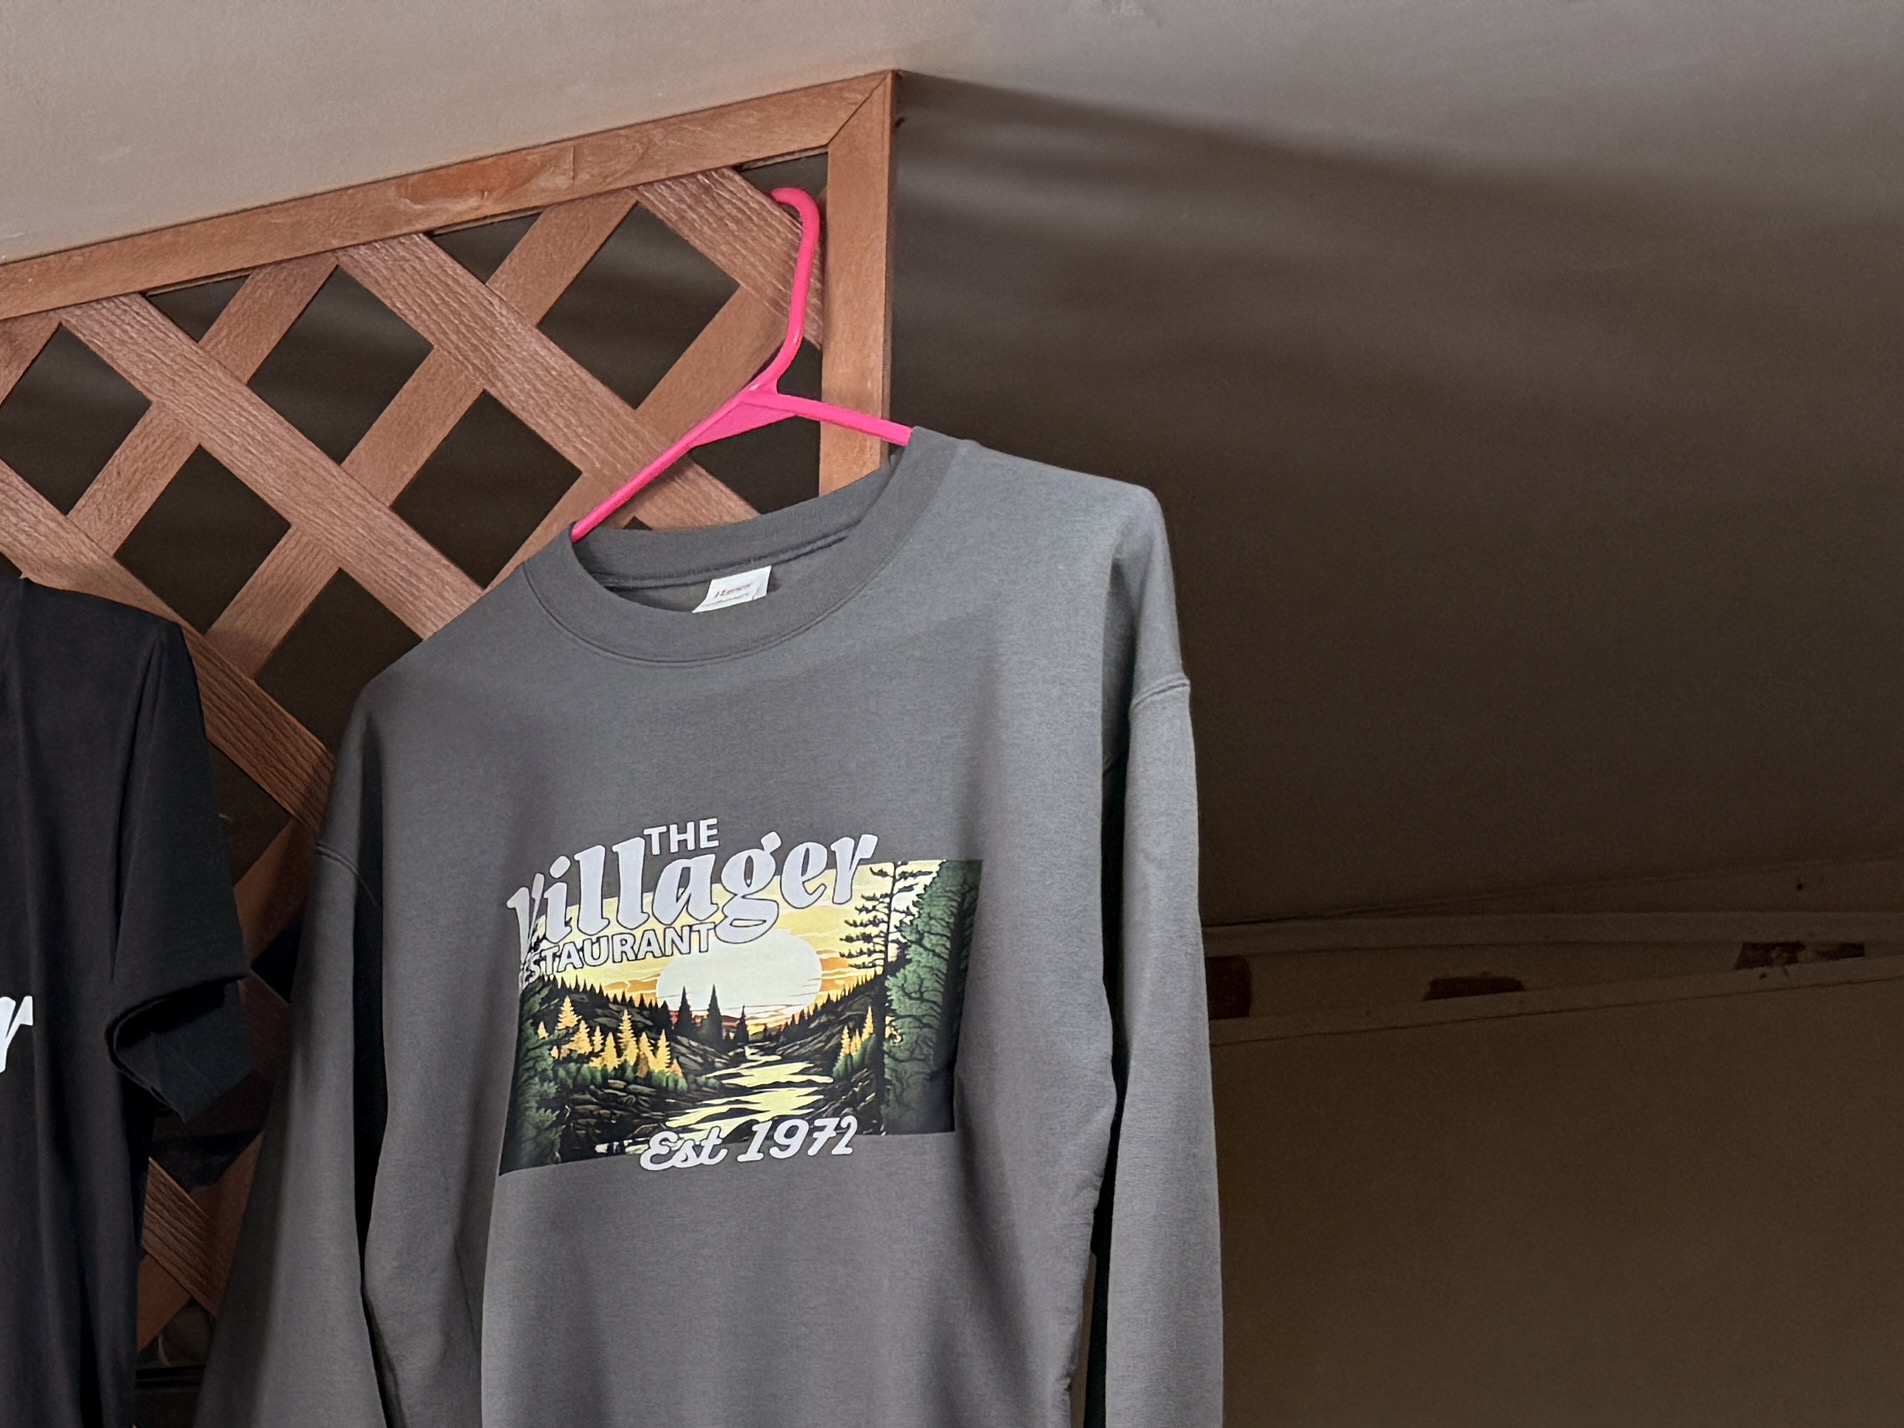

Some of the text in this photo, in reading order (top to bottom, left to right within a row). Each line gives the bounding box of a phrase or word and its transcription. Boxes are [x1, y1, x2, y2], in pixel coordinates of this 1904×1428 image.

[644, 818, 719, 856] THE
[640, 1115, 858, 1171] Est 1972
